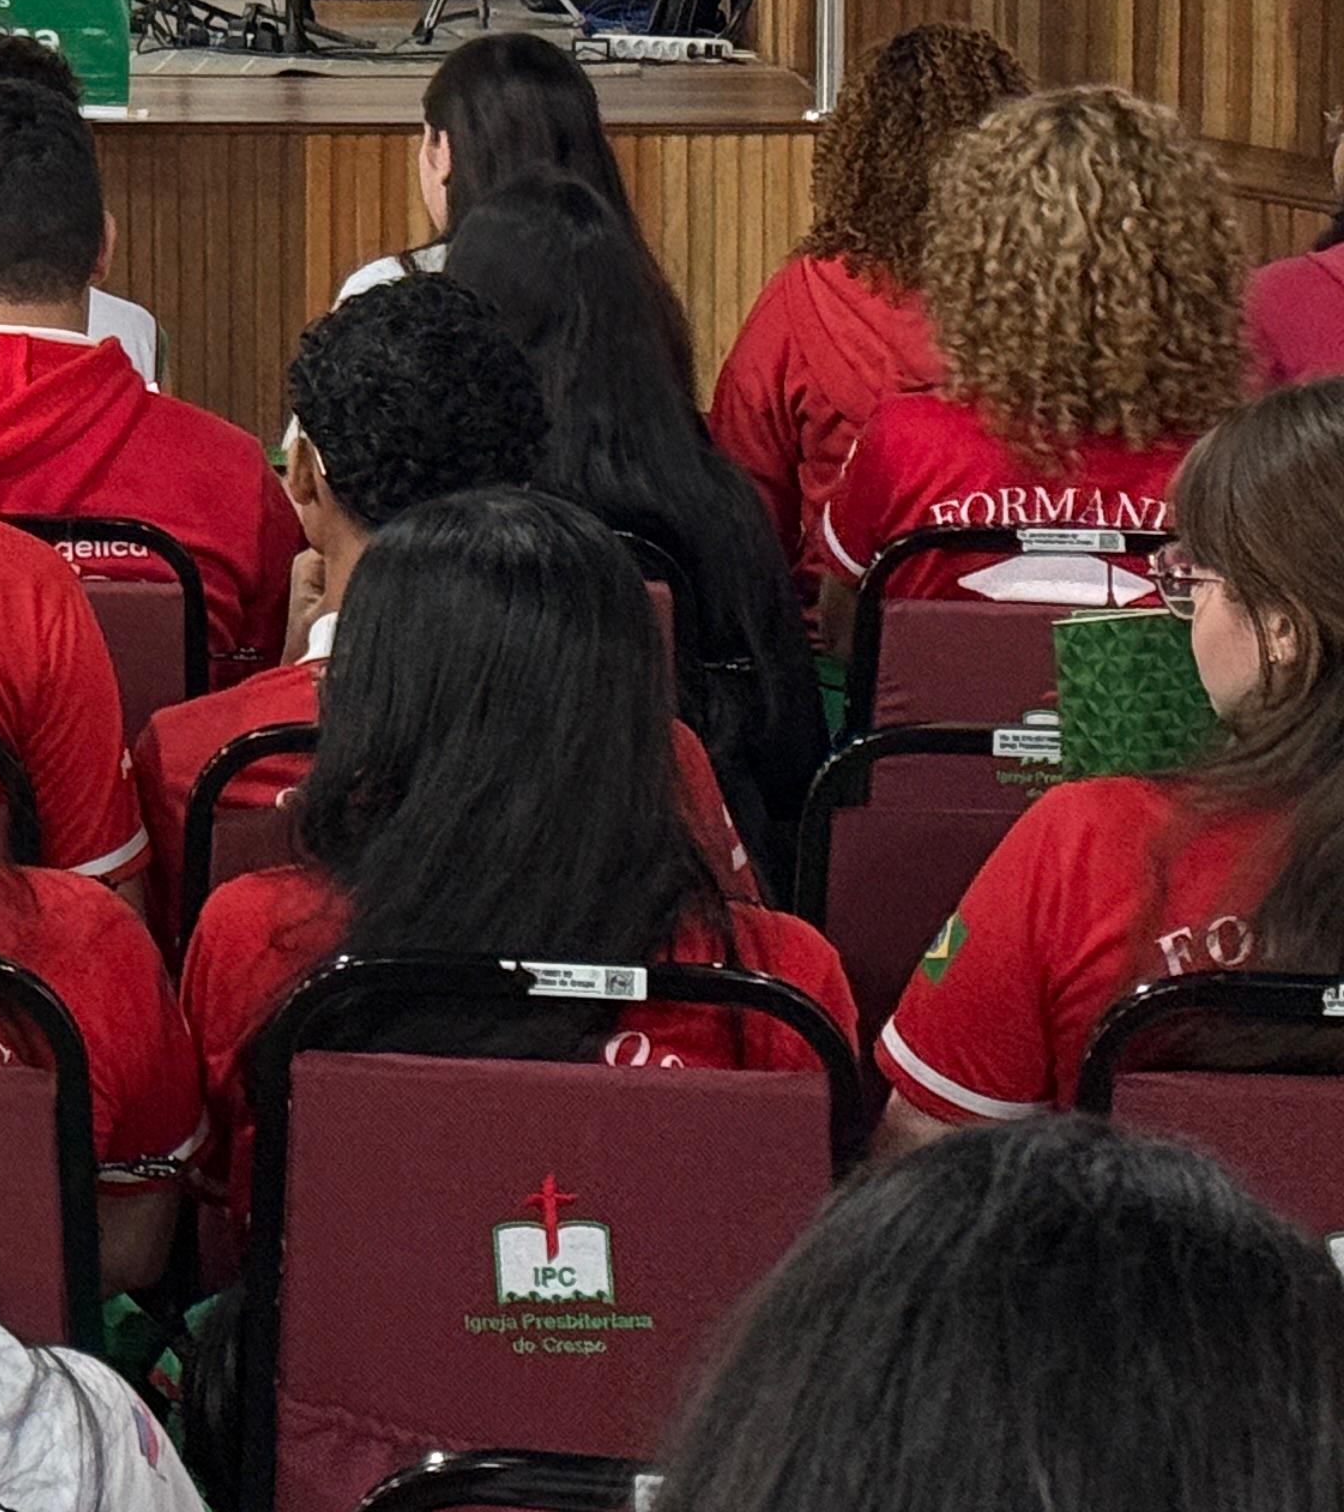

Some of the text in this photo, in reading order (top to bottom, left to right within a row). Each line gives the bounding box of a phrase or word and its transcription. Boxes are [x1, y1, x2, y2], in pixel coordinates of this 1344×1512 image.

[533, 1267, 577, 1288] IPC
[464, 1313, 654, 1334] Igreja Presbiteriana
[513, 1337, 607, 1357] do Crespo
